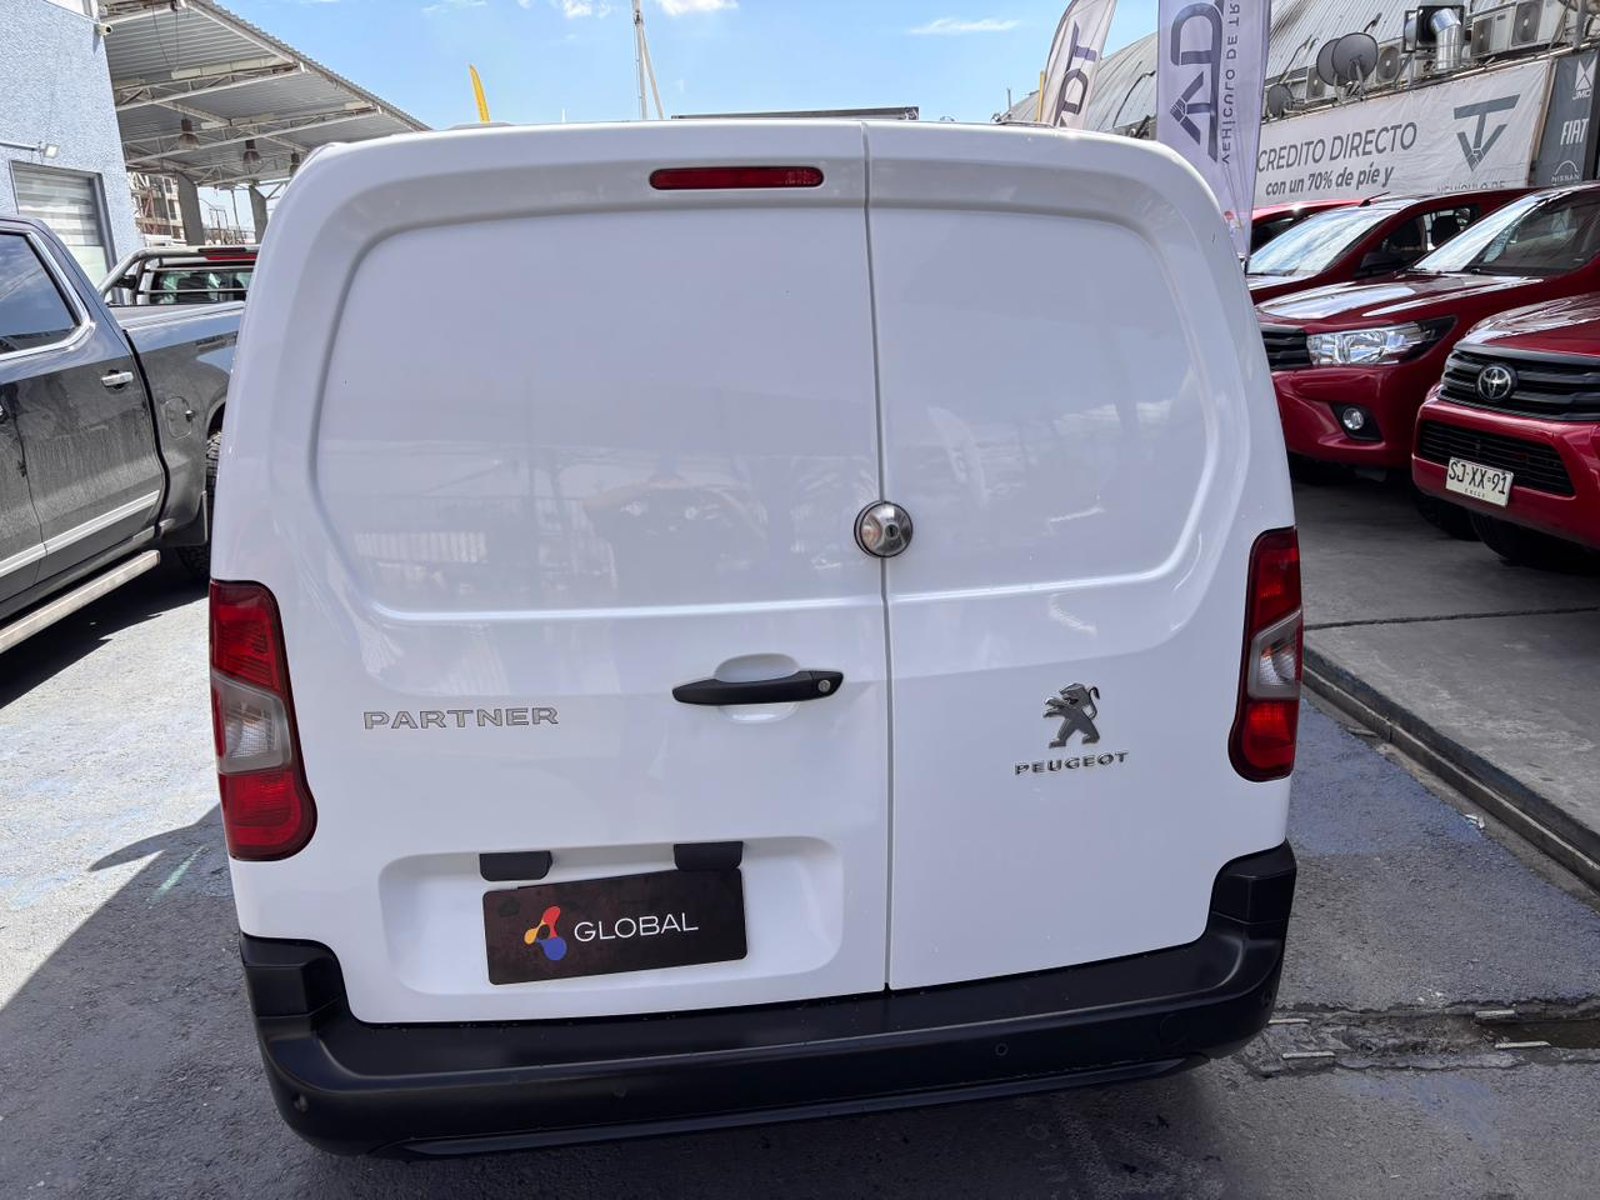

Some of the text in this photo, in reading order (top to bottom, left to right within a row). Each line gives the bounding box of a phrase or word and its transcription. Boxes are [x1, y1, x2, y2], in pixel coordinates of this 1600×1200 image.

[1572, 90, 1592, 100] JMC
[1560, 118, 1589, 145] FIAT
[1256, 121, 1417, 172] CREDITO DIRECTO
[1265, 181, 1286, 196] con
[1289, 176, 1305, 193] un
[1308, 170, 1333, 191] 70%
[1335, 166, 1352, 188] de
[1382, 165, 1395, 188] y
[363, 707, 559, 730] PARTNER
[1015, 751, 1128, 775] PEUGEOT
[574, 912, 699, 942] GLOBAL
